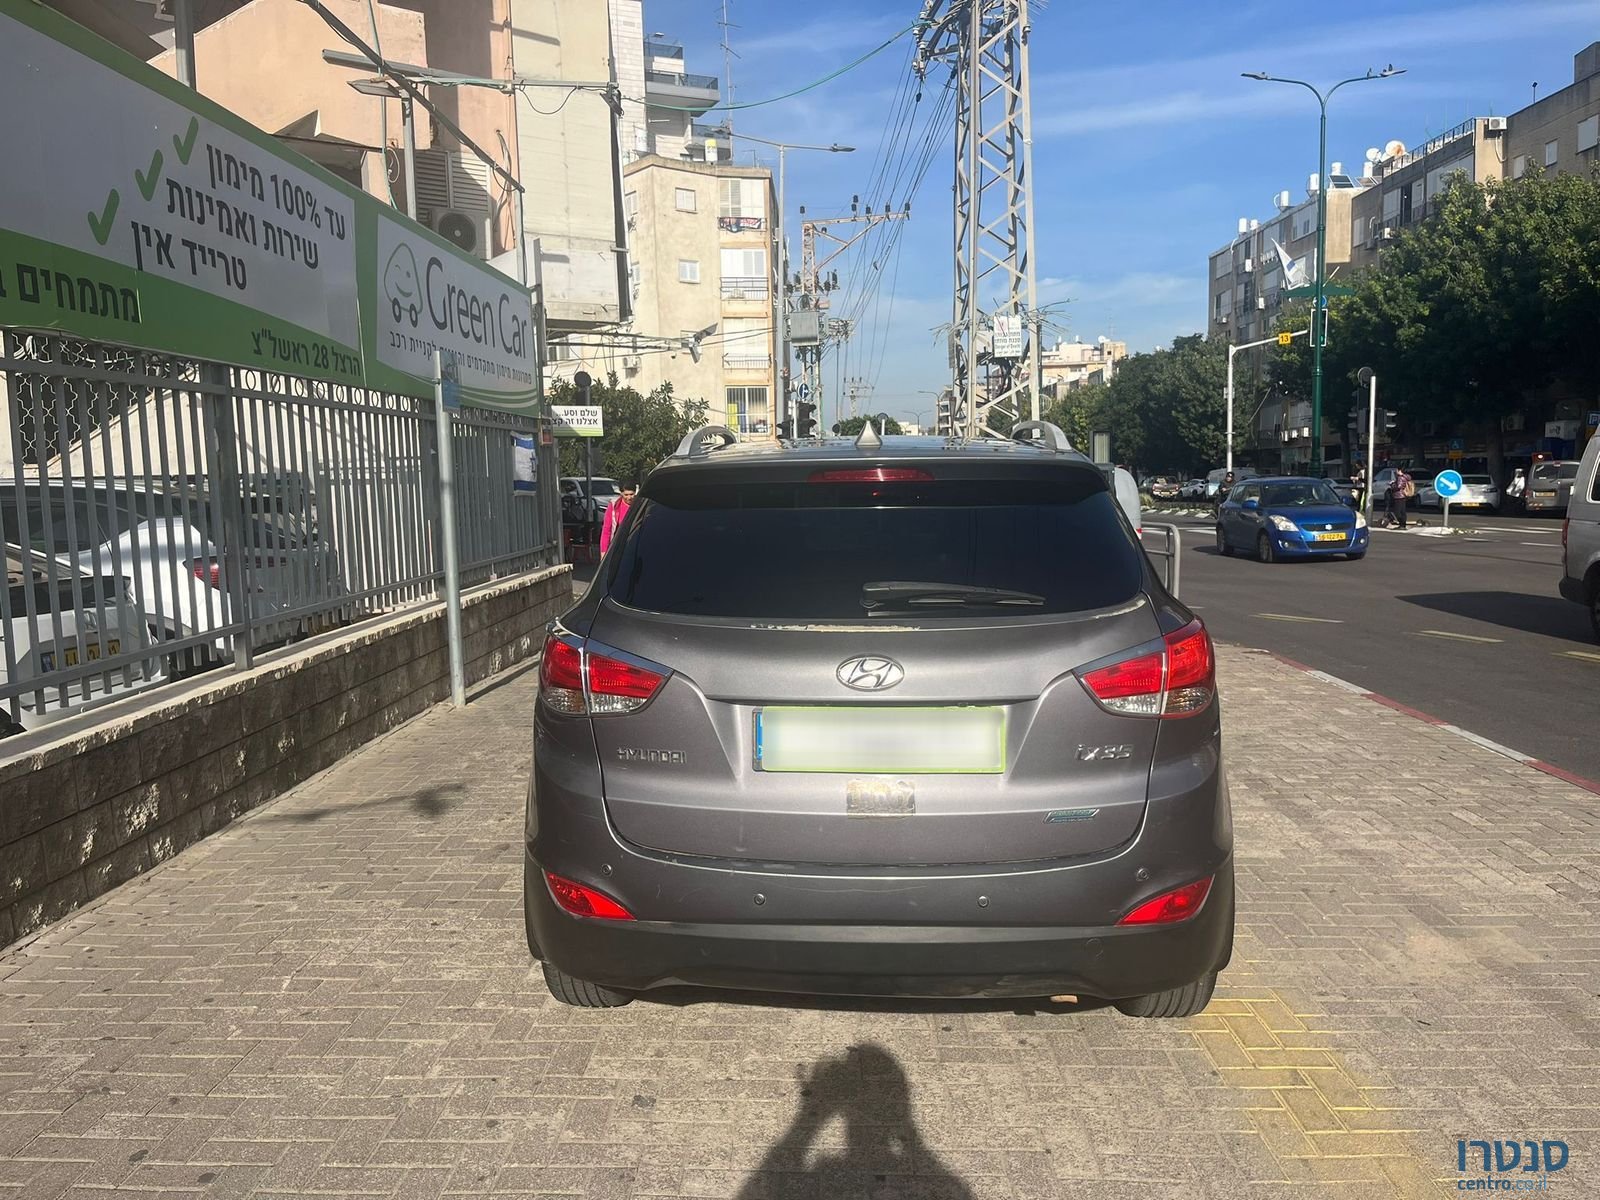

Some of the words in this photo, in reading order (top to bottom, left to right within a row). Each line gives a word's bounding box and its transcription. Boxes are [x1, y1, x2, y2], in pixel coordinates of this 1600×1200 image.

[206, 143, 265, 202] מימון
[166, 177, 257, 247] ואמינות
[270, 173, 321, 230] 100%
[324, 205, 346, 241] עד
[131, 220, 176, 272] אין
[181, 238, 248, 291] טרייד
[262, 219, 319, 270] שירות
[16, 263, 141, 324] מתמחים
[426, 256, 496, 349] Green
[499, 293, 527, 359] Car
[312, 342, 329, 370] 28
[389, 330, 407, 351] רכב
[1280, 334, 1290, 343] 13
[331, 345, 361, 377] הרצל
[576, 417, 598, 425] אצלנו
[580, 408, 598, 417] שלם
[616, 747, 688, 763] HYUNDAI
